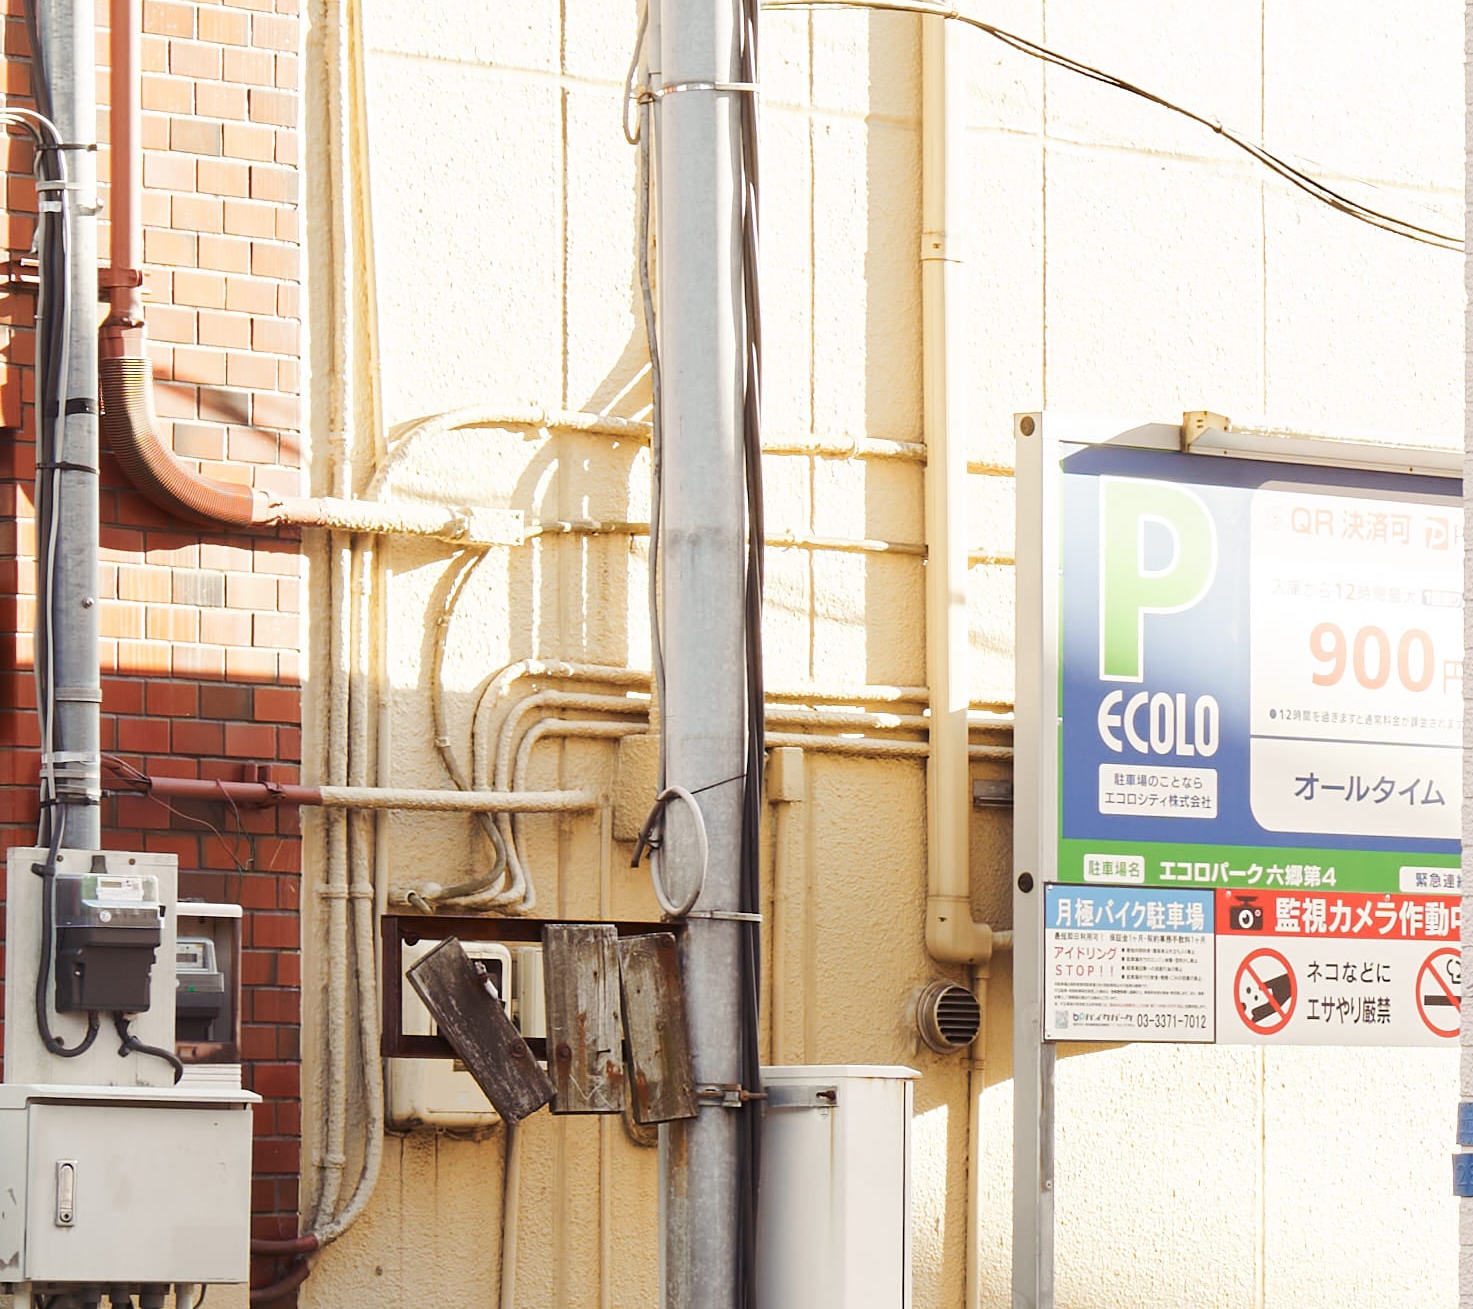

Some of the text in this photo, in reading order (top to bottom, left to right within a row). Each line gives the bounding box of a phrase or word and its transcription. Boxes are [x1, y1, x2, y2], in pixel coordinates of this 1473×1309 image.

[1291, 507, 1334, 535] QR
[1342, 509, 1412, 545] 決済可
[1099, 474, 1218, 683] P
[1098, 690, 1220, 757] ECOLO
[1114, 773, 1203, 789] 駐車場のことなら
[1295, 772, 1445, 806] オールタイム
[1105, 792, 1212, 809] エコロシティ株式会社
[1089, 860, 1140, 878] 駐車場名
[1159, 861, 1336, 886] エコロパーク六郷第4
[1056, 898, 1204, 930] 月極バイク駐車場
[1054, 946, 1117, 960] アイドリング
[1307, 961, 1391, 983] ネコなどに
[1137, 1013, 1207, 1029] 03-3371-7012
[1307, 997, 1391, 1024] エサやり厳禁
